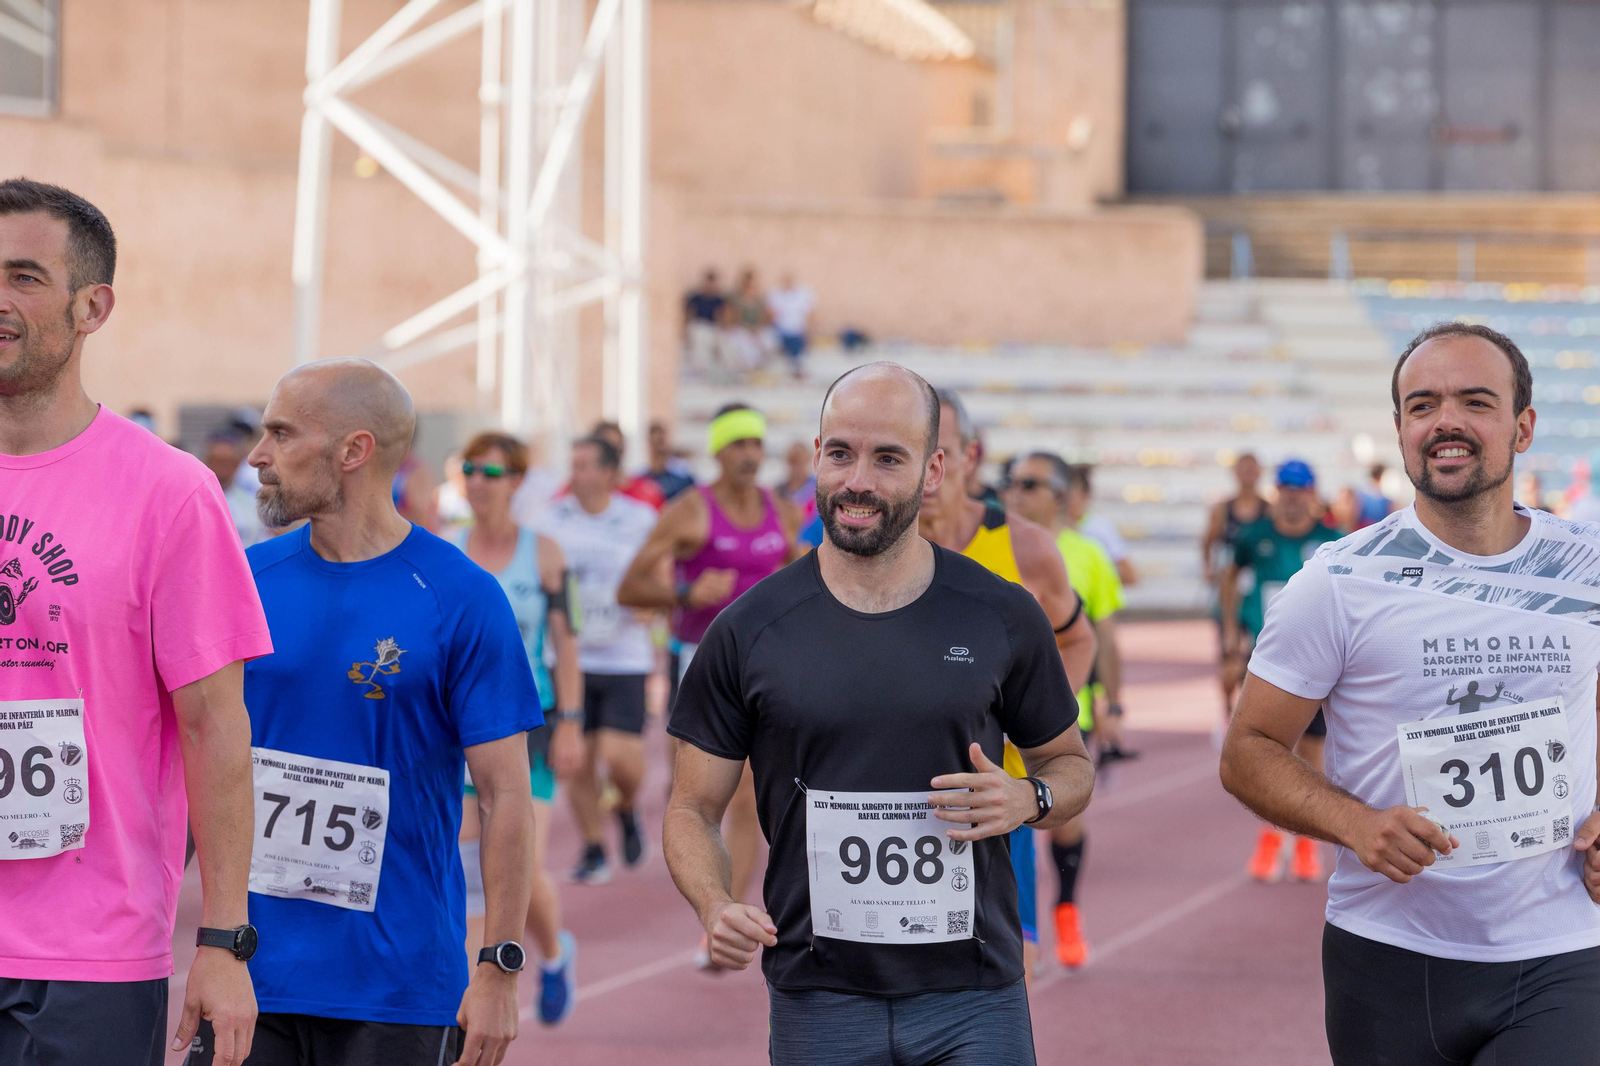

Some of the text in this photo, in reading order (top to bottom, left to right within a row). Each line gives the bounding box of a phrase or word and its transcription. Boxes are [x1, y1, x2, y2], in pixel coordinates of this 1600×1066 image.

[32, 532, 79, 586] SHOP
[1423, 635, 1571, 653] MEMORIAL
[0, 658, 19, 667] otor
[943, 655, 975, 664] Kalenji
[1423, 652, 1571, 666] SARGENTO DE INFANTERIA
[1423, 664, 1571, 677] DE MARINA CARMONA PAEZ
[1503, 690, 1524, 703] CLUB
[9, 709, 45, 720] INFANTERÍA
[46, 709, 55, 718] DE
[55, 708, 79, 718] MARINA
[17, 720, 34, 730] PÁEZ
[1406, 706, 1561, 740] XXXV MEMORIAL SARGENTO DE INFANTERÍA DE MARINA
[1453, 723, 1521, 743] RAFAEL CARMONA PÁEZ
[260, 758, 287, 770] MEMORIAL
[288, 763, 315, 775] SARGENTO
[315, 768, 324, 776] DE
[324, 769, 357, 782] INFANTERÍA
[357, 775, 366, 783] DE
[366, 776, 386, 787] MARINA
[1439, 746, 1545, 808] 310
[282, 772, 345, 789] RAFAEL CARMONA PÁEZ
[814, 800, 829, 809] XXXV
[829, 802, 861, 811] MEMORIAL
[861, 802, 893, 811] SARGENTO
[894, 802, 904, 811] DE
[10, 812, 38, 820] MELERO
[262, 791, 357, 851] 715
[858, 811, 927, 820] RAFAEL CARMONA PÁEZ
[1449, 821, 1475, 830] RAFAEL
[1475, 816, 1513, 827] FERNÁNDEZ
[1512, 810, 1540, 821] RAMÍREZ
[19, 829, 50, 837] RECOSUR
[1519, 826, 1546, 836] RECOSUR
[290, 858, 313, 867] ORTEGA
[313, 862, 331, 870] SEIJO
[839, 835, 945, 886] 968
[850, 898, 875, 906] ÁLVARO
[909, 915, 938, 923] RECOSUR
